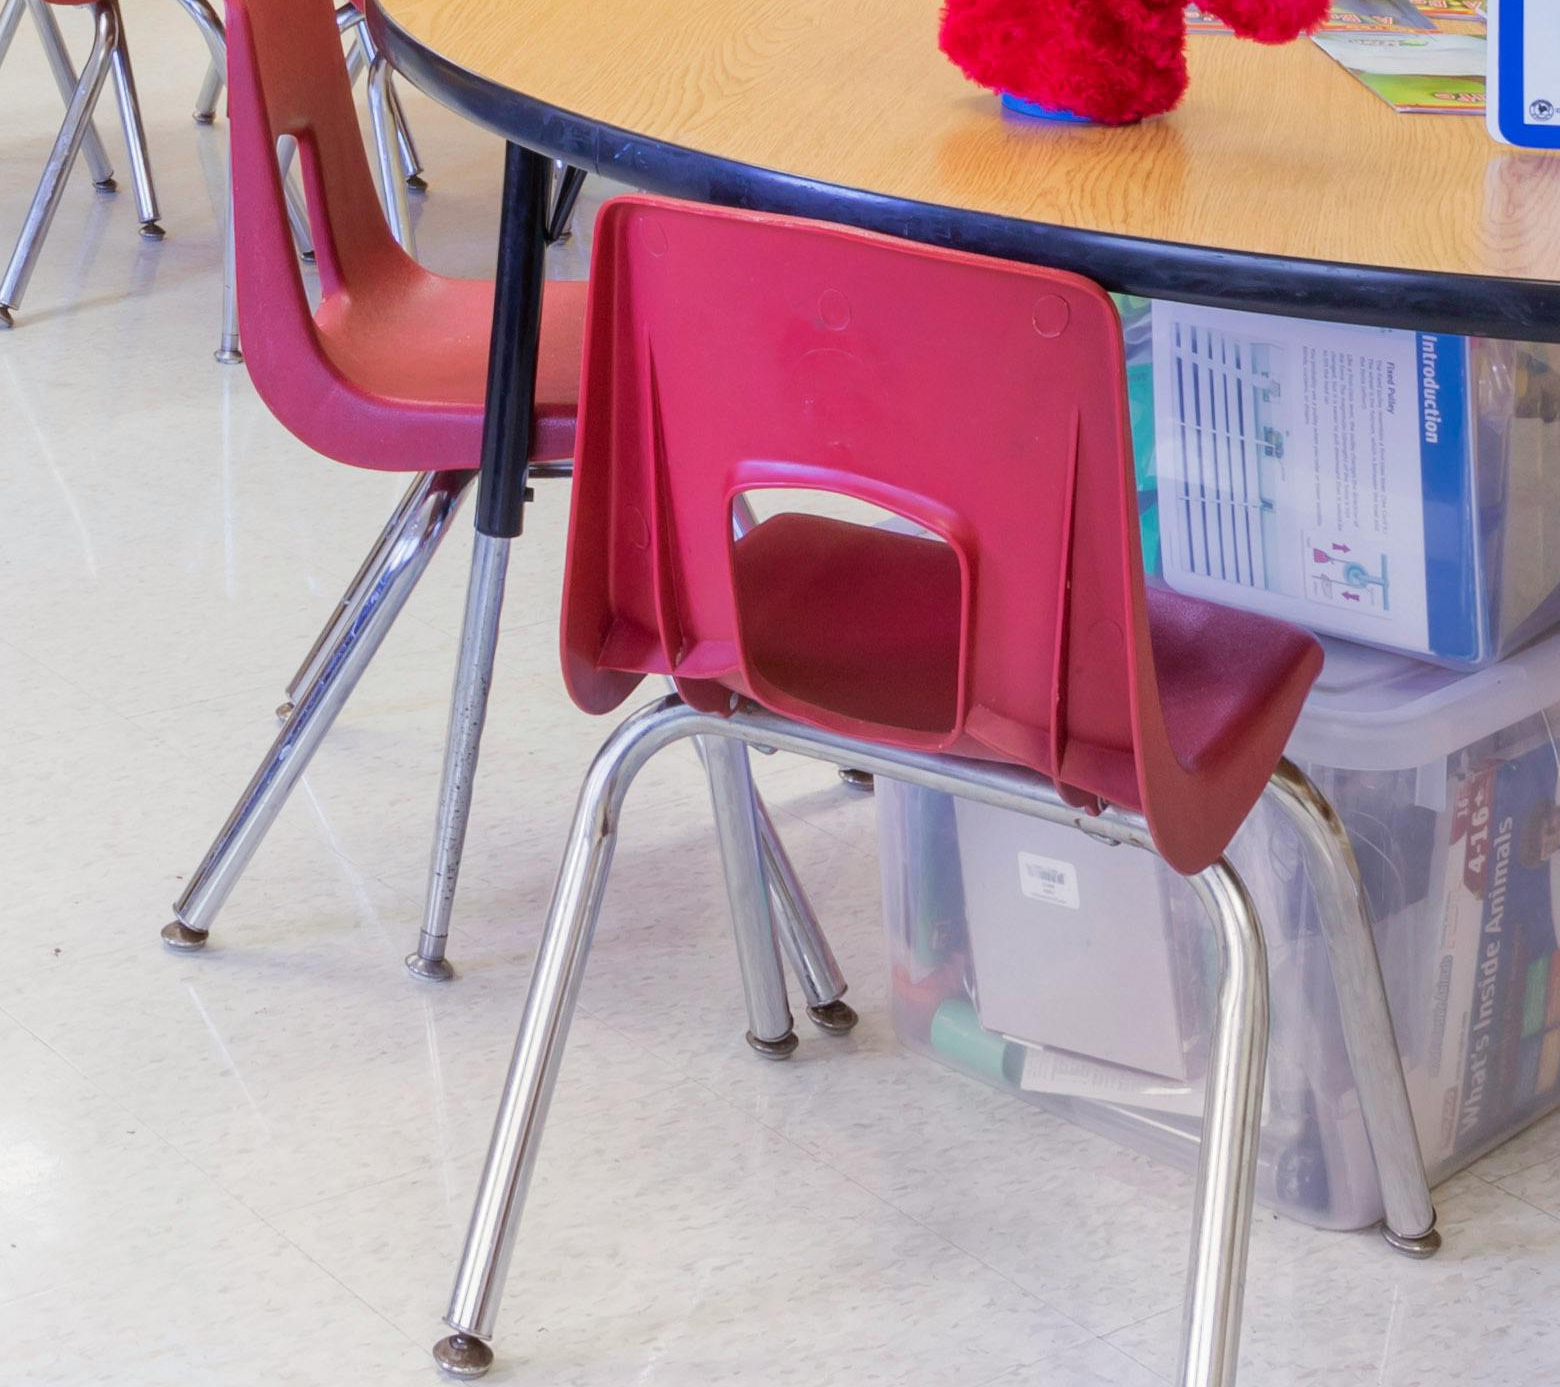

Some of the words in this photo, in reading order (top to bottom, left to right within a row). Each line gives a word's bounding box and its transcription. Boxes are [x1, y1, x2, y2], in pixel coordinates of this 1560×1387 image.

[1386, 362, 1395, 385] Fixed
[1386, 387, 1396, 415] Pulley
[1421, 334, 1438, 444] Introduction
[1467, 787, 1489, 874] 4-16+
[1484, 815, 1514, 933] Animals
[1474, 940, 1501, 1032] Inside
[1459, 1033, 1490, 1136] What's
